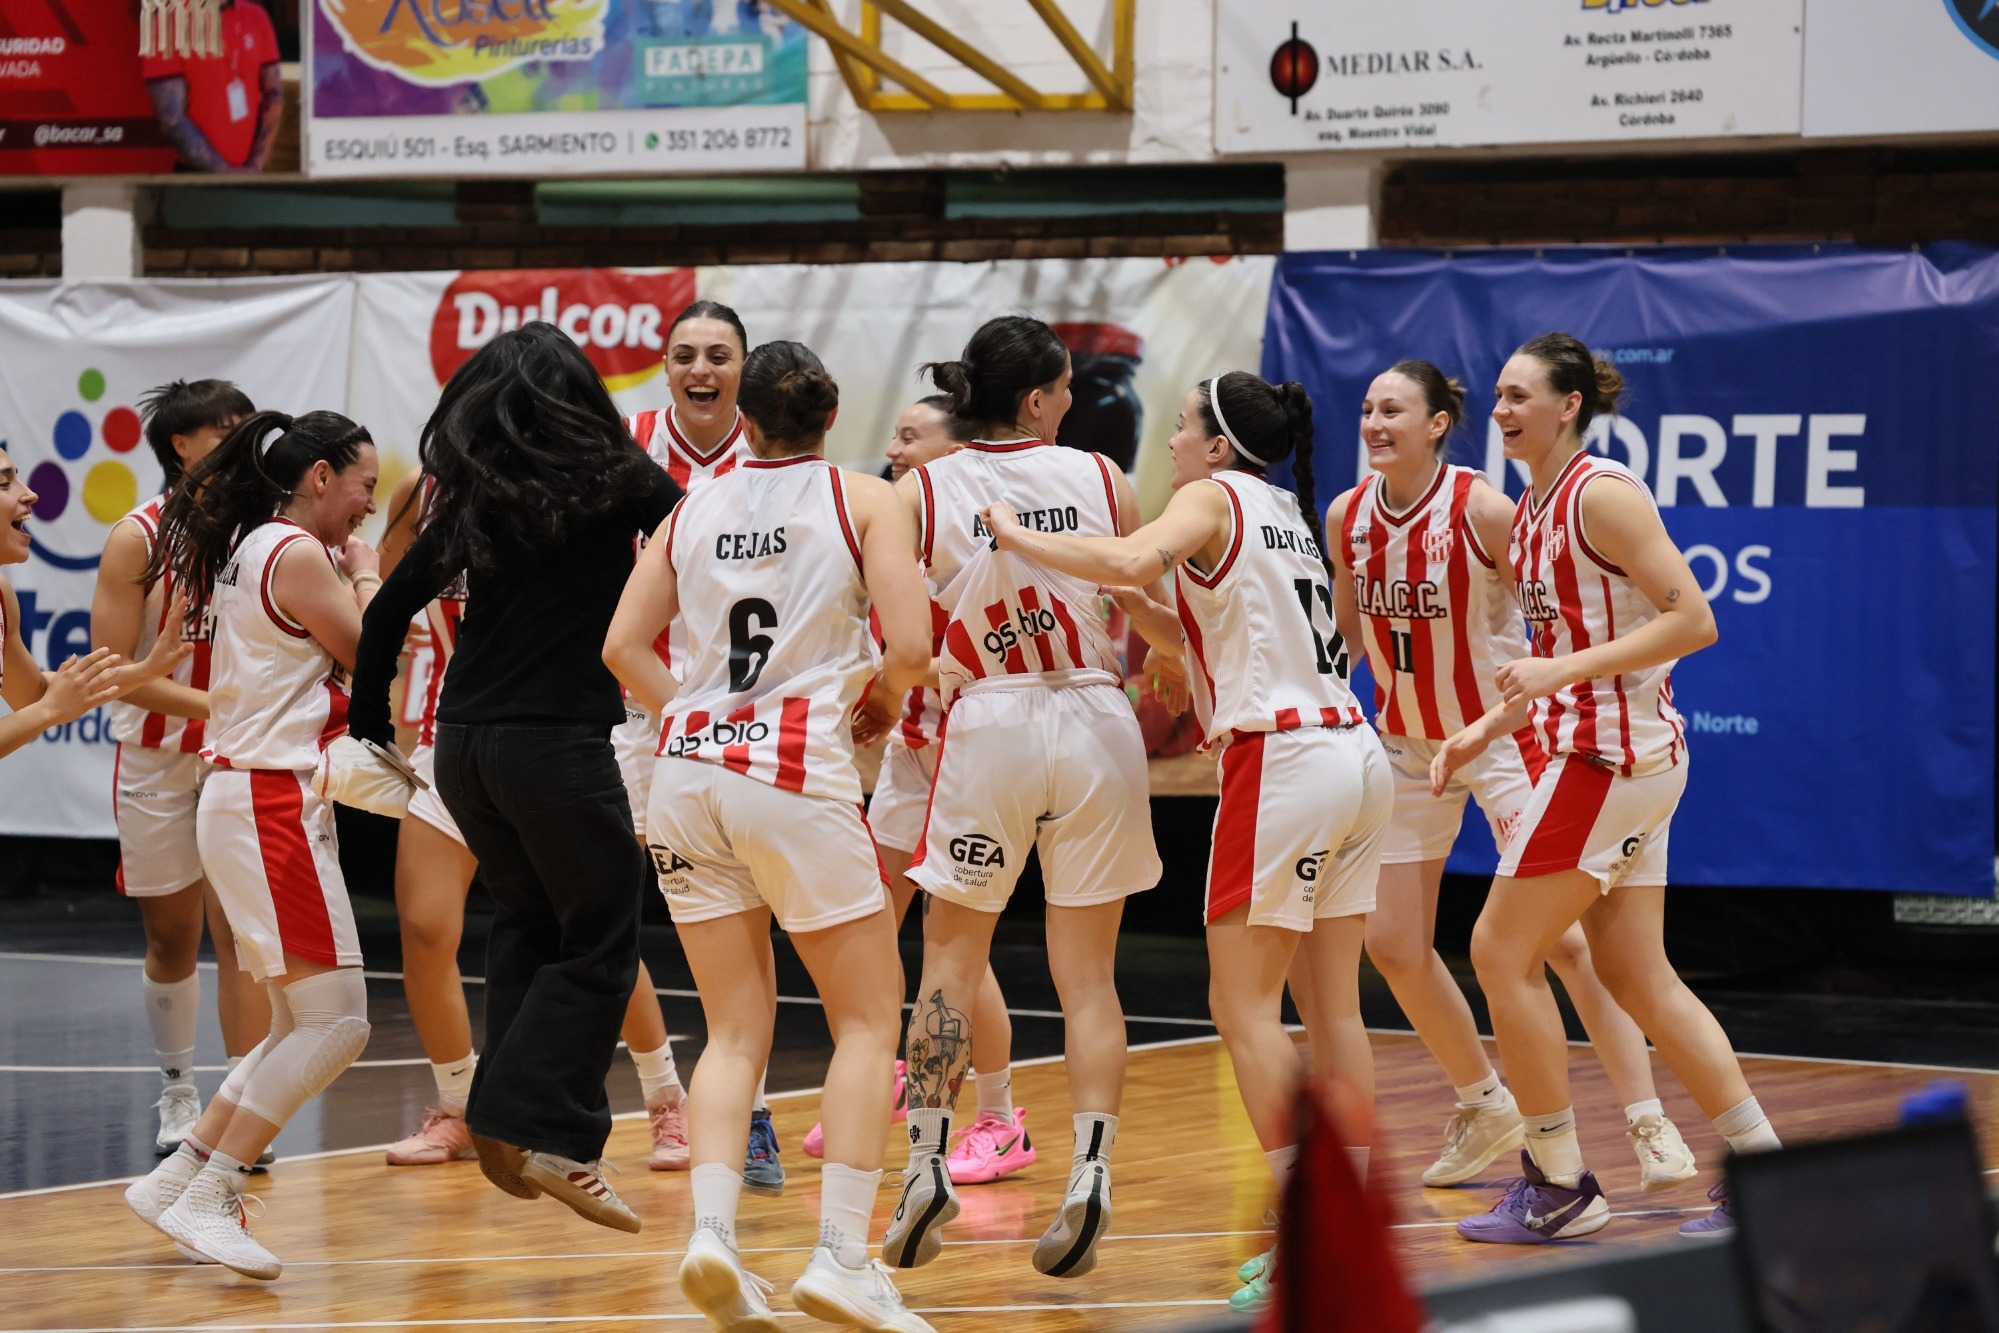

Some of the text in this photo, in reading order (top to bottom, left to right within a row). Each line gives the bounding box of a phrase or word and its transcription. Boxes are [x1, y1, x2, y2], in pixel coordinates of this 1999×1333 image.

[474, 31, 593, 58] Pinturerías
[1564, 24, 1732, 47] Av. Recta Martinolli 7365
[1326, 48, 1484, 76] MEDIAR S.A.
[1590, 94, 1610, 107] Av.
[1614, 90, 1666, 106] Richieri
[1327, 106, 1368, 121] Duarte
[34, 123, 123, 147] @bacar_sa
[404, 137, 435, 158] 501
[498, 132, 616, 156] SARMIENTO
[666, 129, 697, 151] 351
[702, 128, 738, 150] 206
[744, 126, 792, 149] 8772
[1348, 126, 1398, 139] Maestro
[1404, 123, 1436, 137] Vidal
[715, 526, 788, 561] CEJAS
[1293, 578, 1349, 680] 12
[728, 597, 778, 694] 6
[1692, 710, 1759, 735] Norte
[949, 837, 1005, 869] GEA
[953, 873, 988, 887] de salud
[954, 865, 994, 878] cobertura
